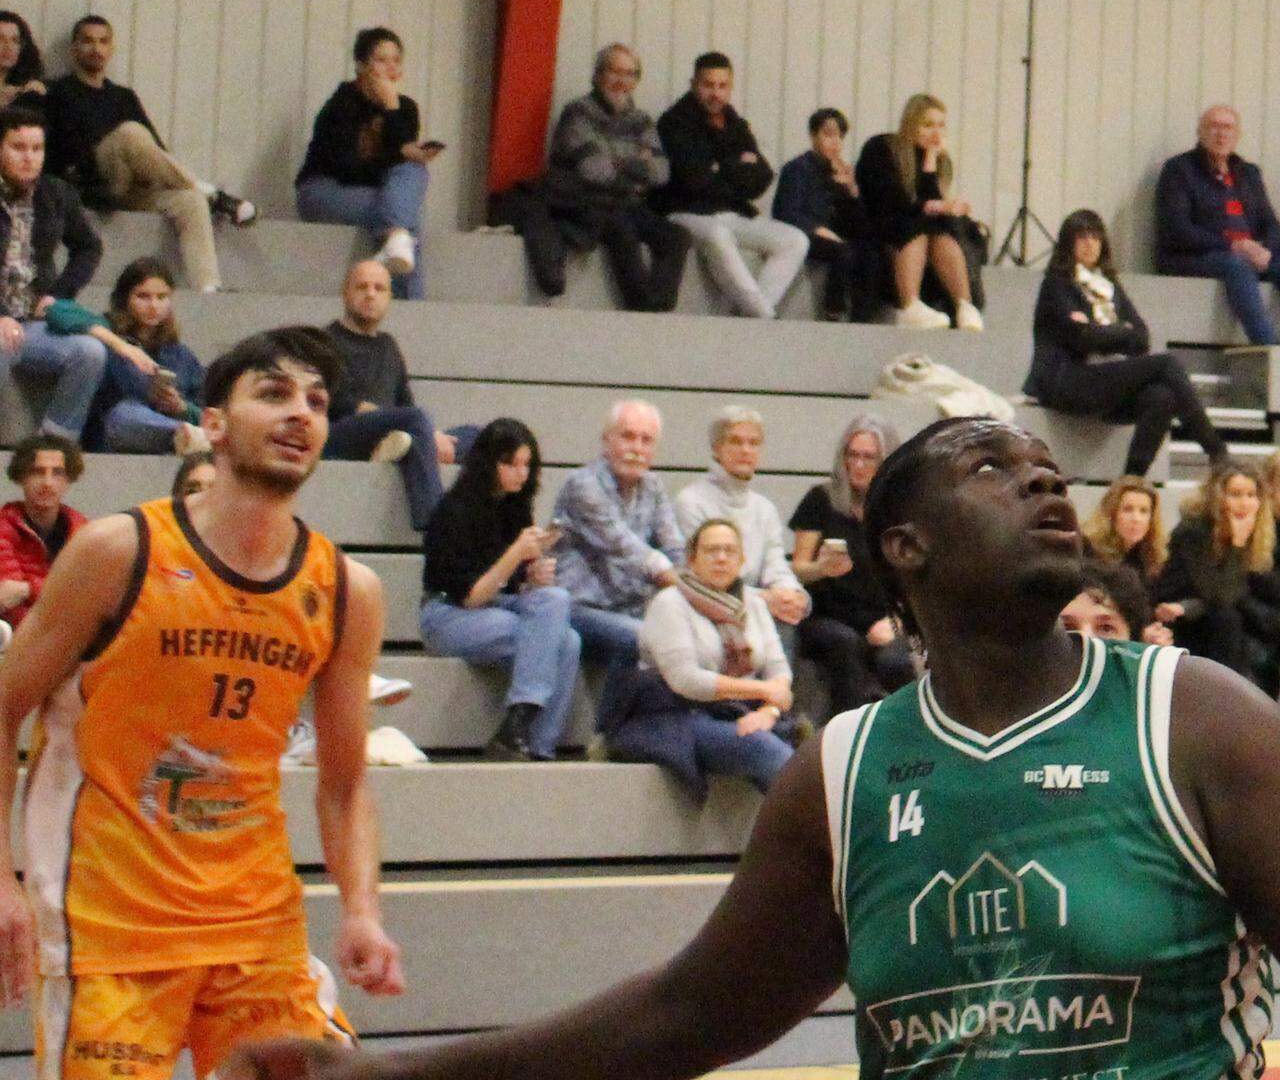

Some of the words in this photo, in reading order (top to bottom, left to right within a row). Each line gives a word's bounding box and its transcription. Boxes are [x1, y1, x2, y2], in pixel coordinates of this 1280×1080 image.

[160, 628, 316, 676] HEFFINGEN
[209, 673, 256, 720] 13
[888, 788, 926, 843] 14
[968, 887, 1011, 936] ITE
